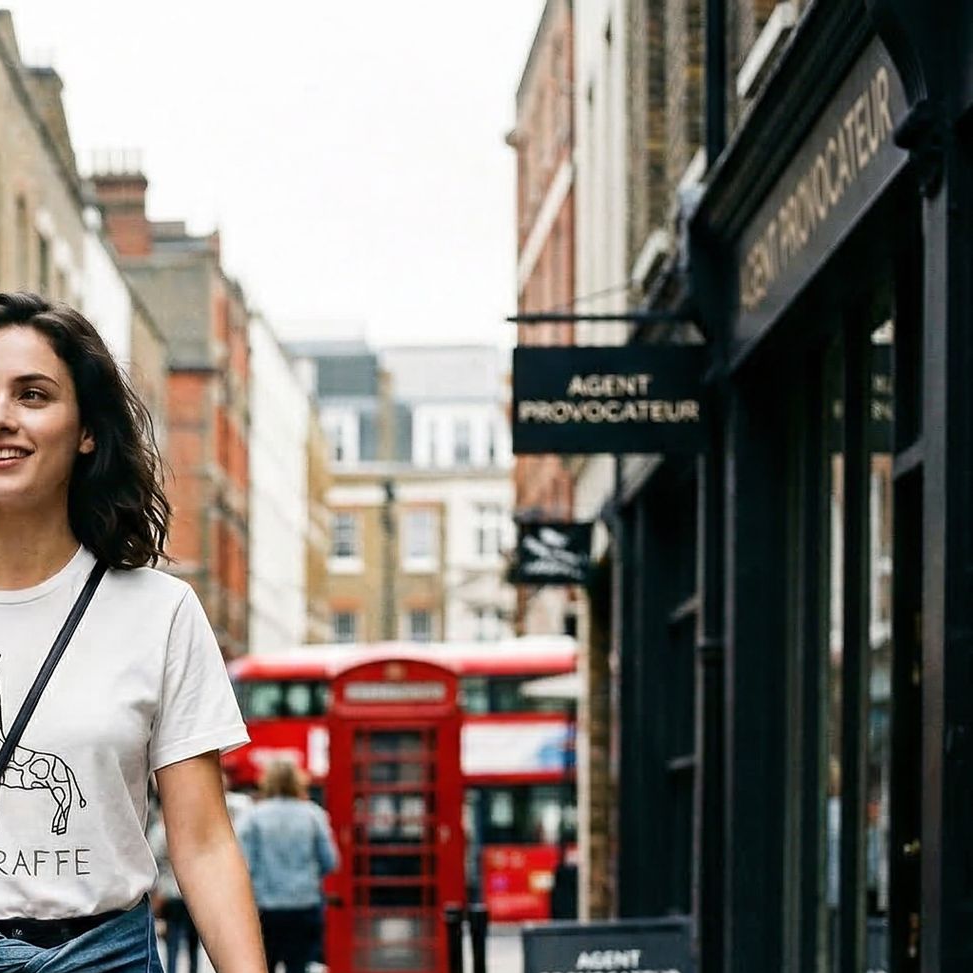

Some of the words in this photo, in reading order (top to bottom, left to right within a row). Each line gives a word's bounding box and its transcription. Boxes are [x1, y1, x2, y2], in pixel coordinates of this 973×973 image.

[740, 219, 778, 309] GENT
[779, 66, 893, 270] PROVOCATEUR
[567, 374, 653, 397] AGENT
[519, 400, 700, 423] PROVOCATEUR
[576, 949, 641, 970] AGENT
